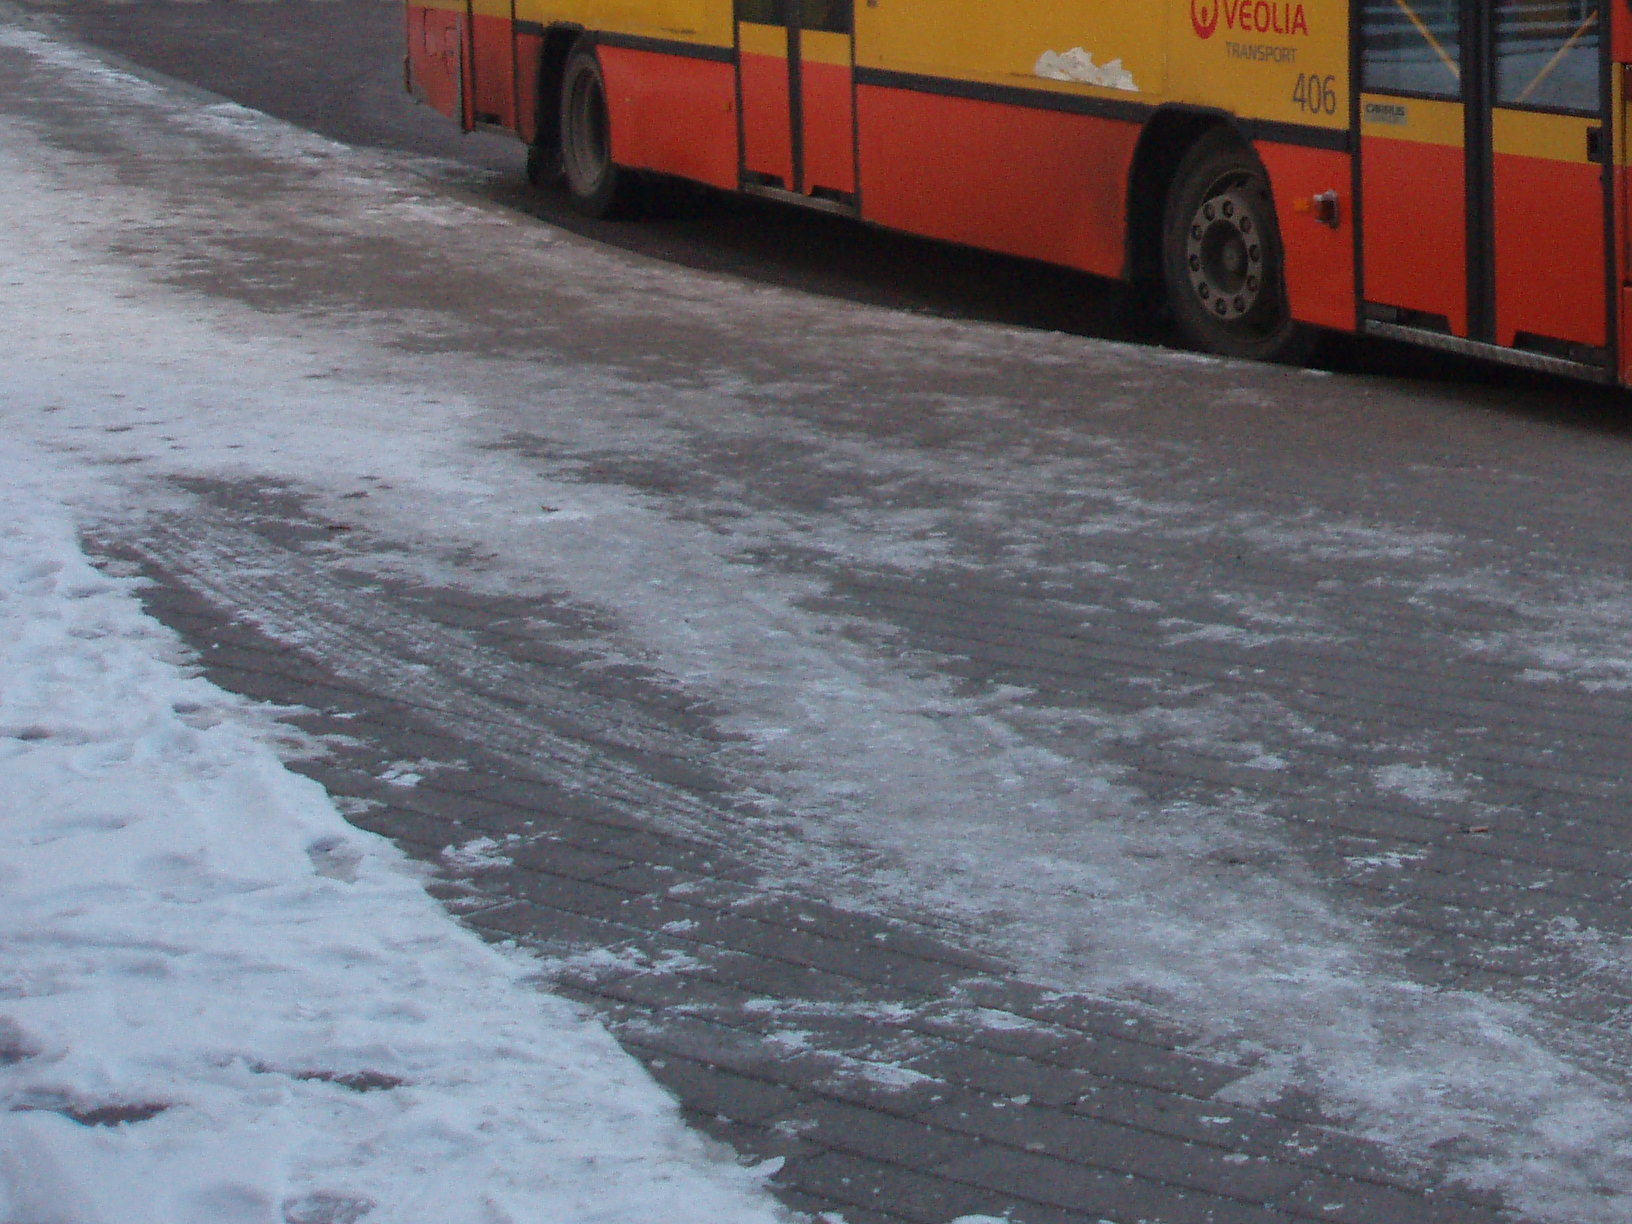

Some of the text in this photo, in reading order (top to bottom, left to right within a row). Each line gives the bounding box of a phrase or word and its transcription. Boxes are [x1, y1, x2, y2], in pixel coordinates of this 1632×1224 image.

[1223, 0, 1309, 37] VEOLIA
[1226, 41, 1298, 64] TRANSPORT
[1293, 73, 1337, 115] 406
